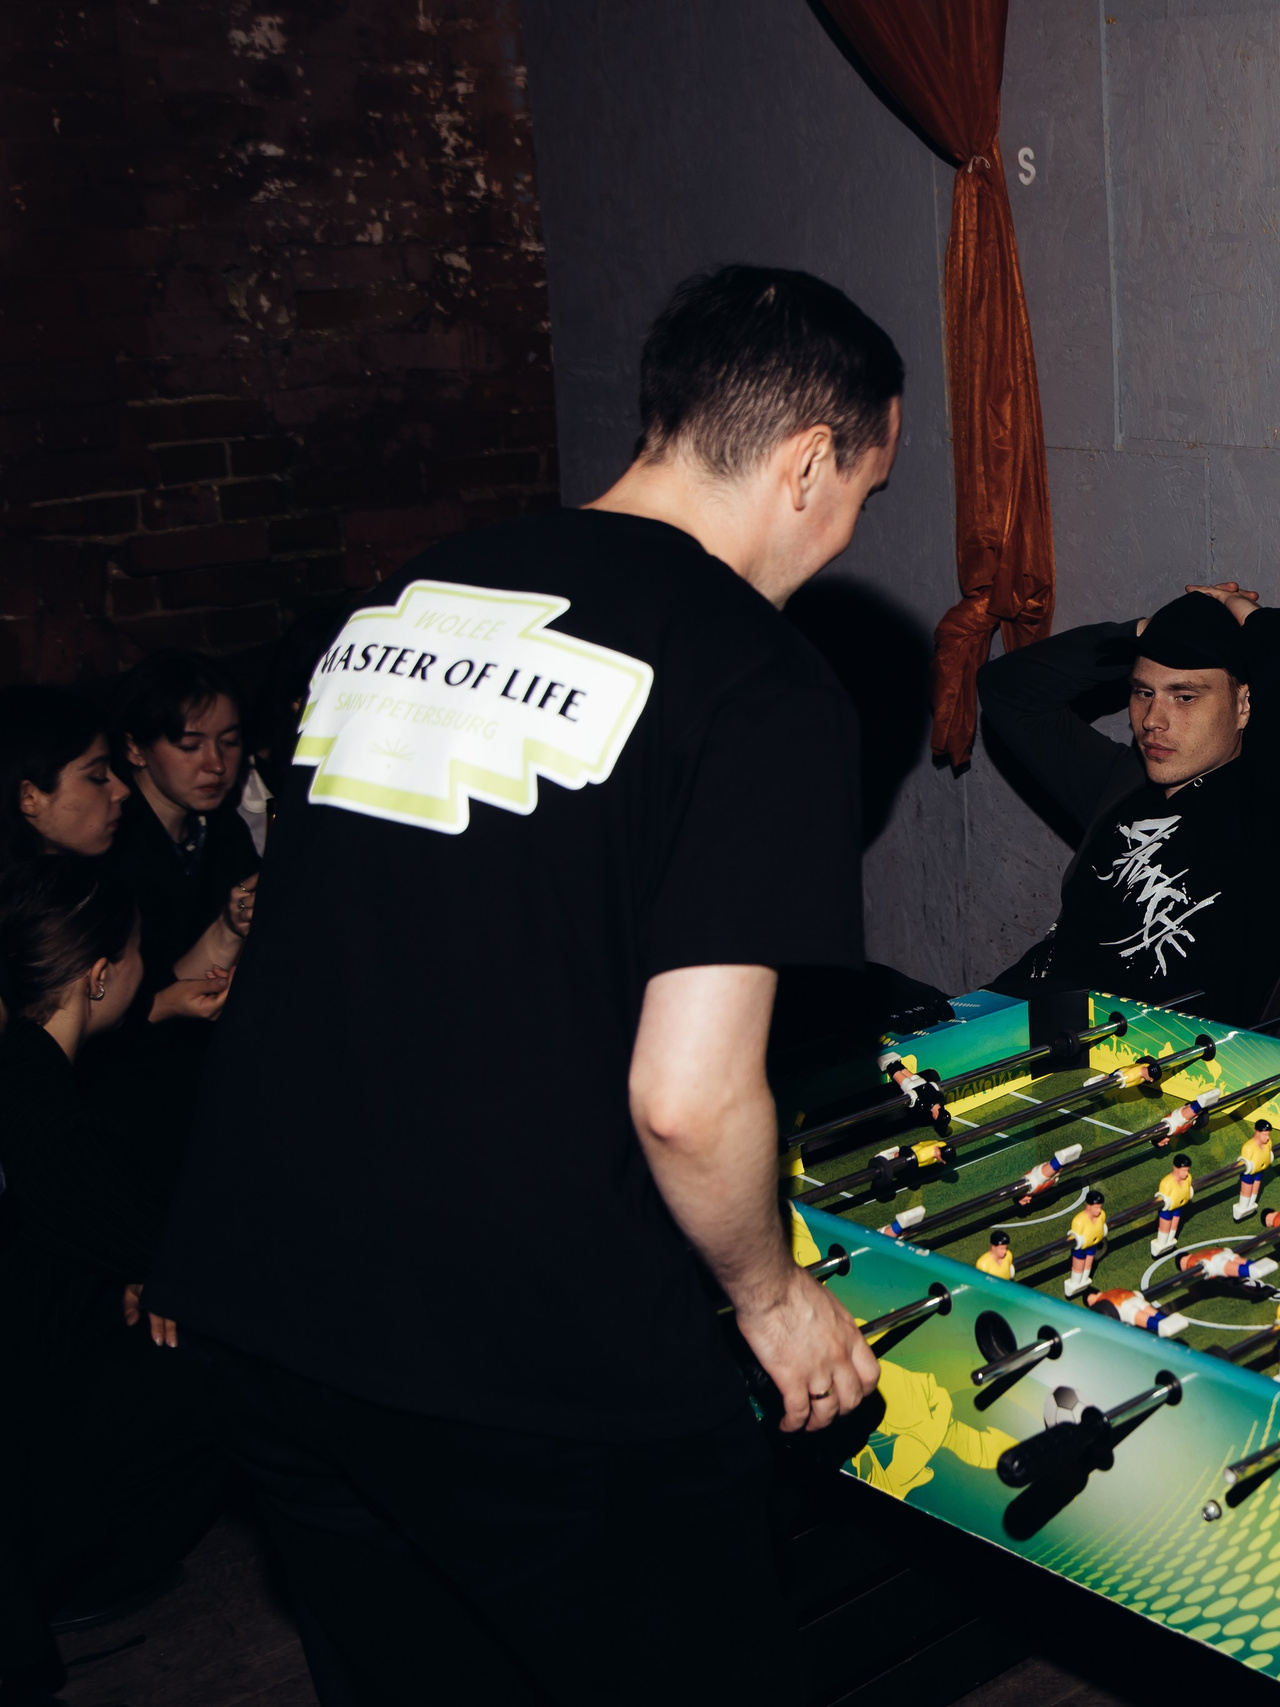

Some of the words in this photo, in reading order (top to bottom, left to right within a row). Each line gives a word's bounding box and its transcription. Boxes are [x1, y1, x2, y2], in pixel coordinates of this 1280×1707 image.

[1018, 147, 1036, 185] S
[321, 643, 438, 681] MASTER
[444, 659, 498, 690] OF
[500, 669, 586, 721] LIFE
[334, 692, 378, 712] SAINT
[376, 698, 499, 740] PETERSBURG
